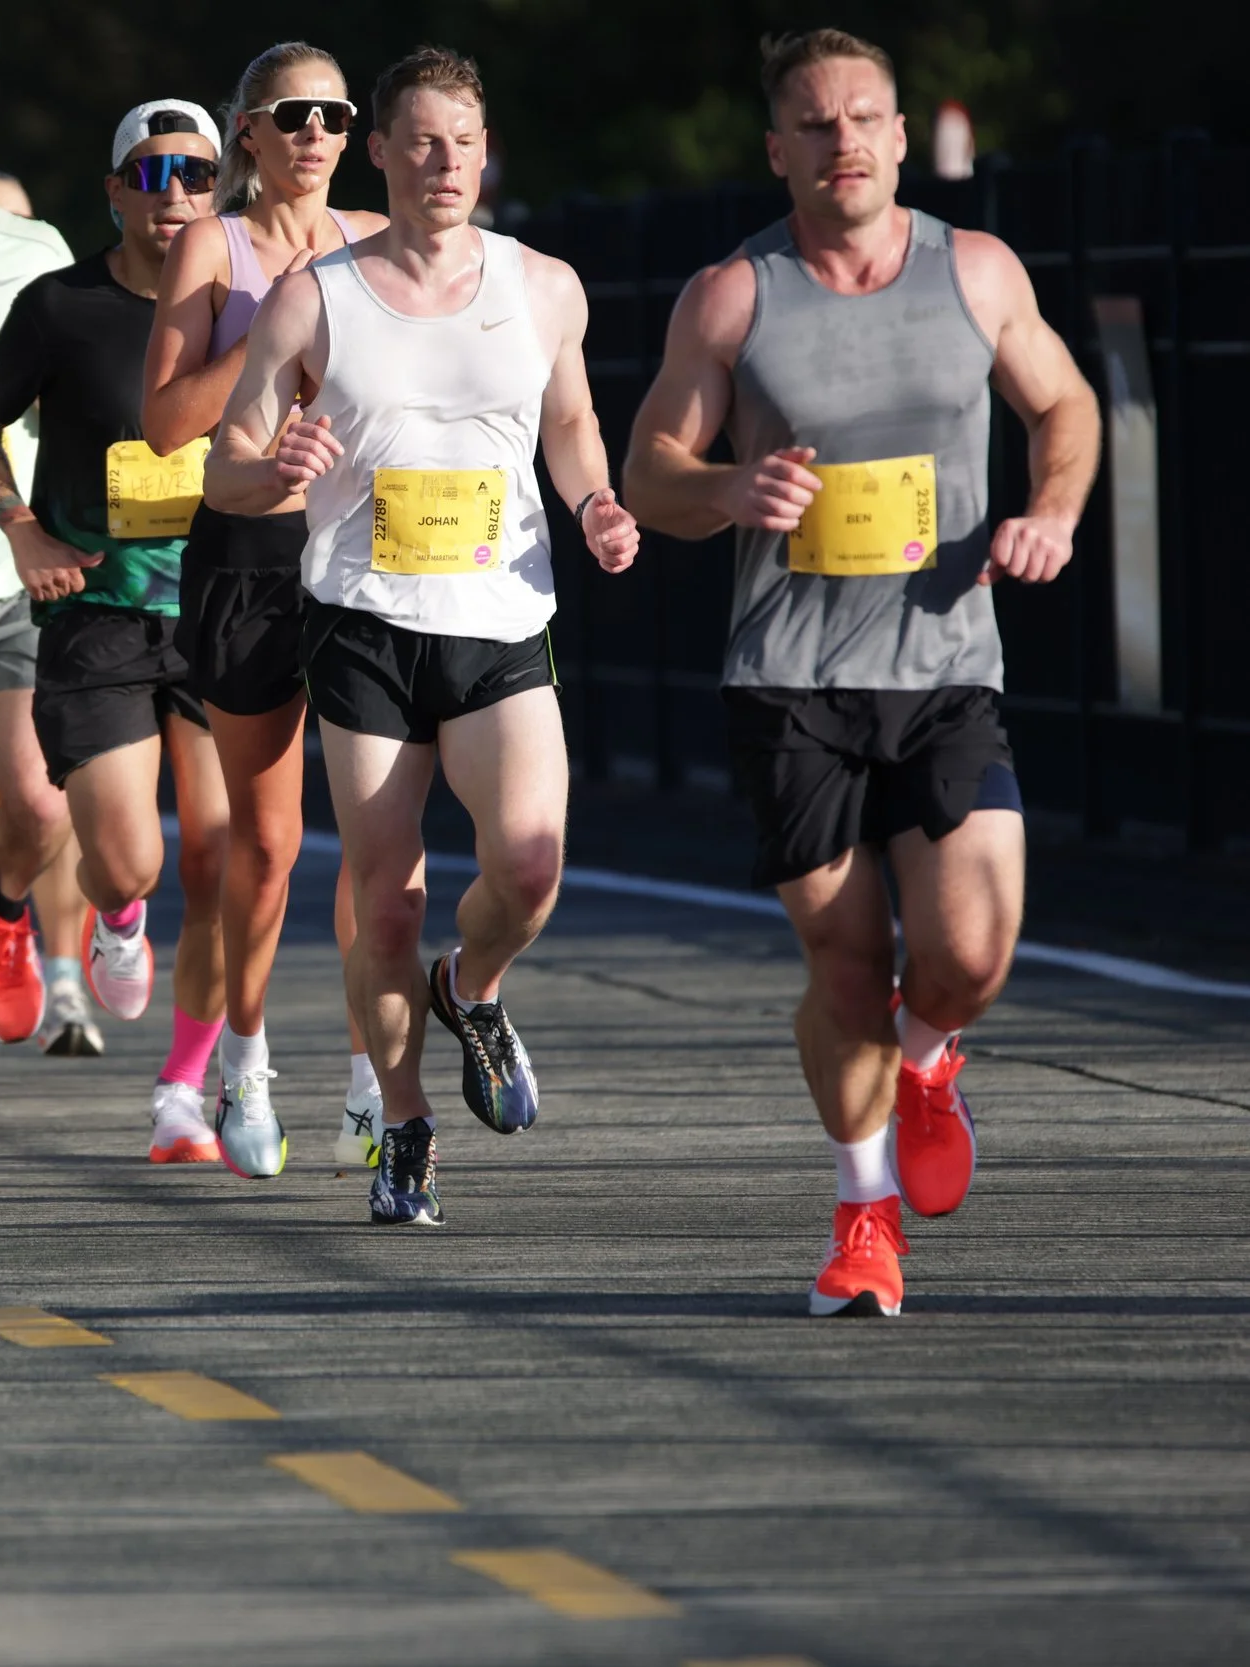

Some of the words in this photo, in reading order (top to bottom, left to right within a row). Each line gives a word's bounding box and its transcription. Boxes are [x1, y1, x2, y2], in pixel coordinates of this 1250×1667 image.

[109, 468, 121, 510] 26072
[477, 481, 488, 491] A
[374, 498, 387, 541] 22789
[417, 516, 459, 526] JOHAN
[487, 499, 501, 541] 22789
[846, 513, 872, 524] BEN
[916, 488, 930, 536] 23624
